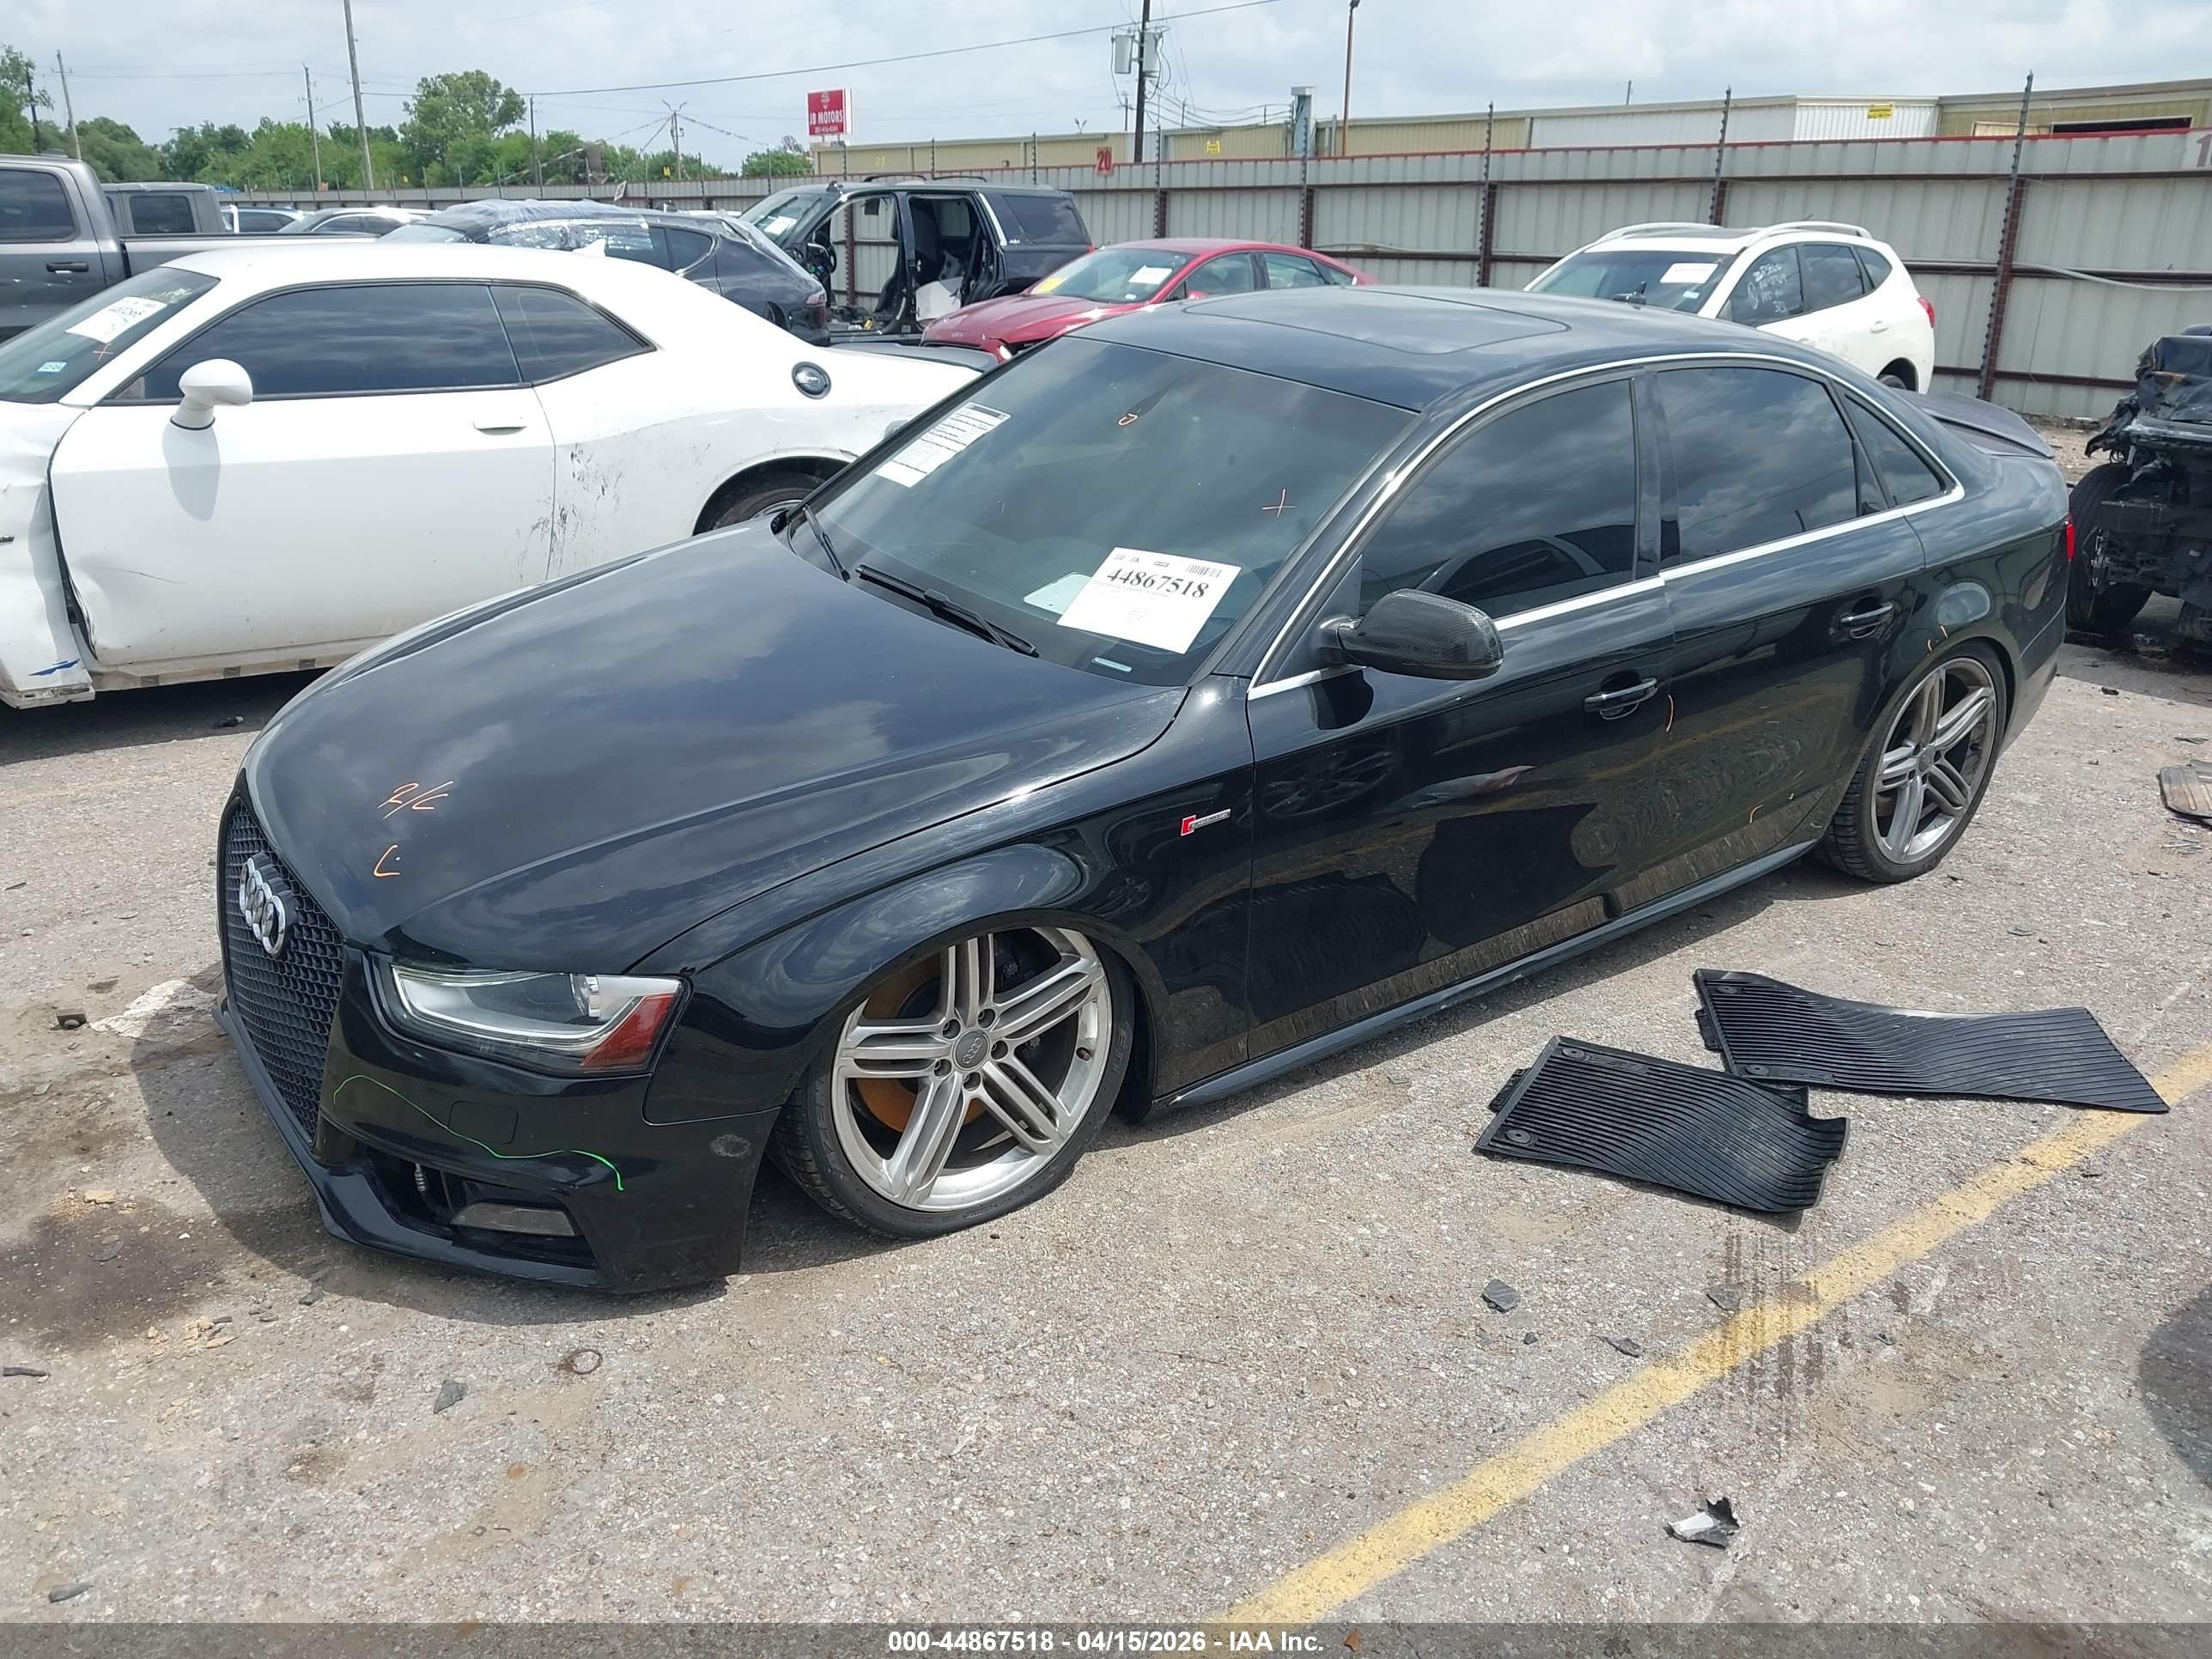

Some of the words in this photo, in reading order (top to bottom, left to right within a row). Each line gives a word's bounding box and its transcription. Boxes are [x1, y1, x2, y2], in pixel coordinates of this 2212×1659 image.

[817, 109, 843, 125] MOTORS
[1097, 150, 1112, 171] 20
[2197, 133, 2212, 167] 1
[1106, 568, 1210, 599] 44867518
